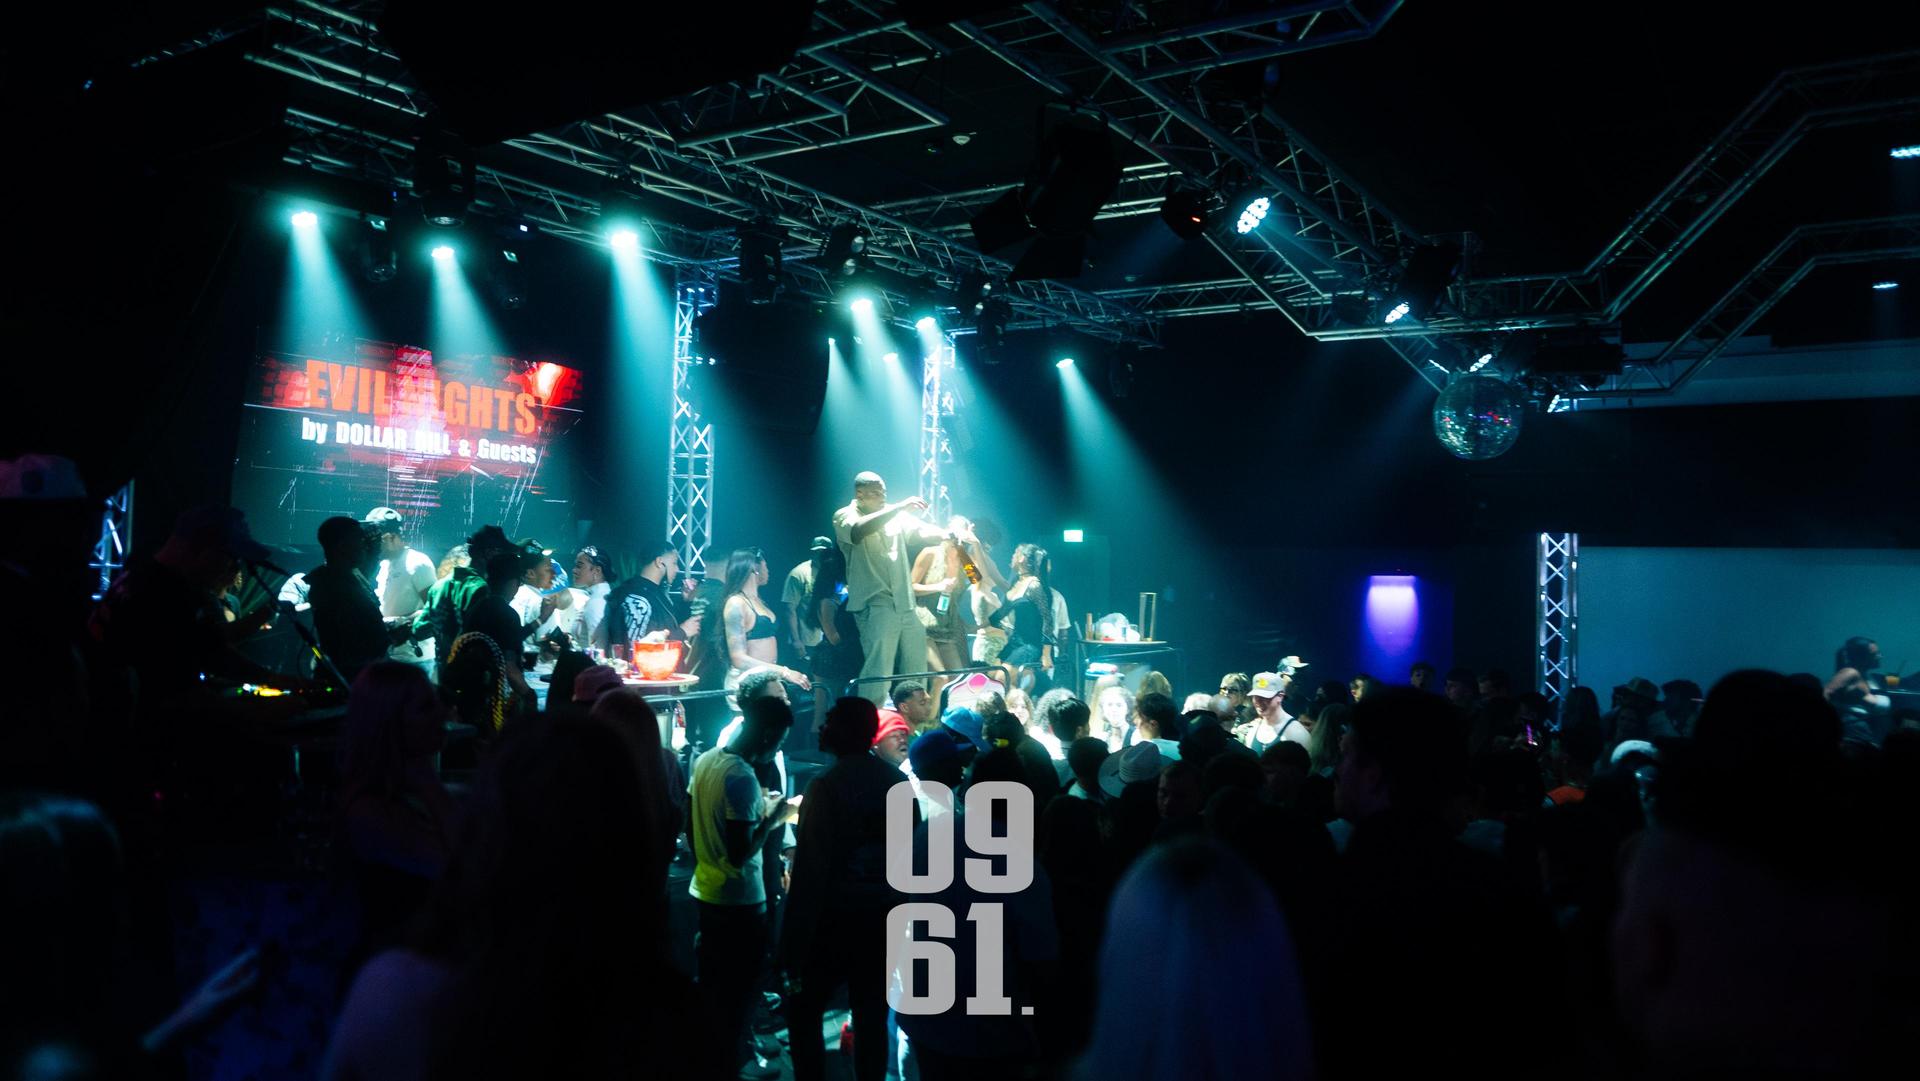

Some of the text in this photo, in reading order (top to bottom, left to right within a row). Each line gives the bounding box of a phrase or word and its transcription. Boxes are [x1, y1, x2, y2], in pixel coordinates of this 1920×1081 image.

[306, 359, 392, 416] EVIL
[301, 416, 328, 444] by
[335, 421, 407, 450] DOLLAR
[457, 439, 472, 458] &
[477, 438, 536, 464] Guests
